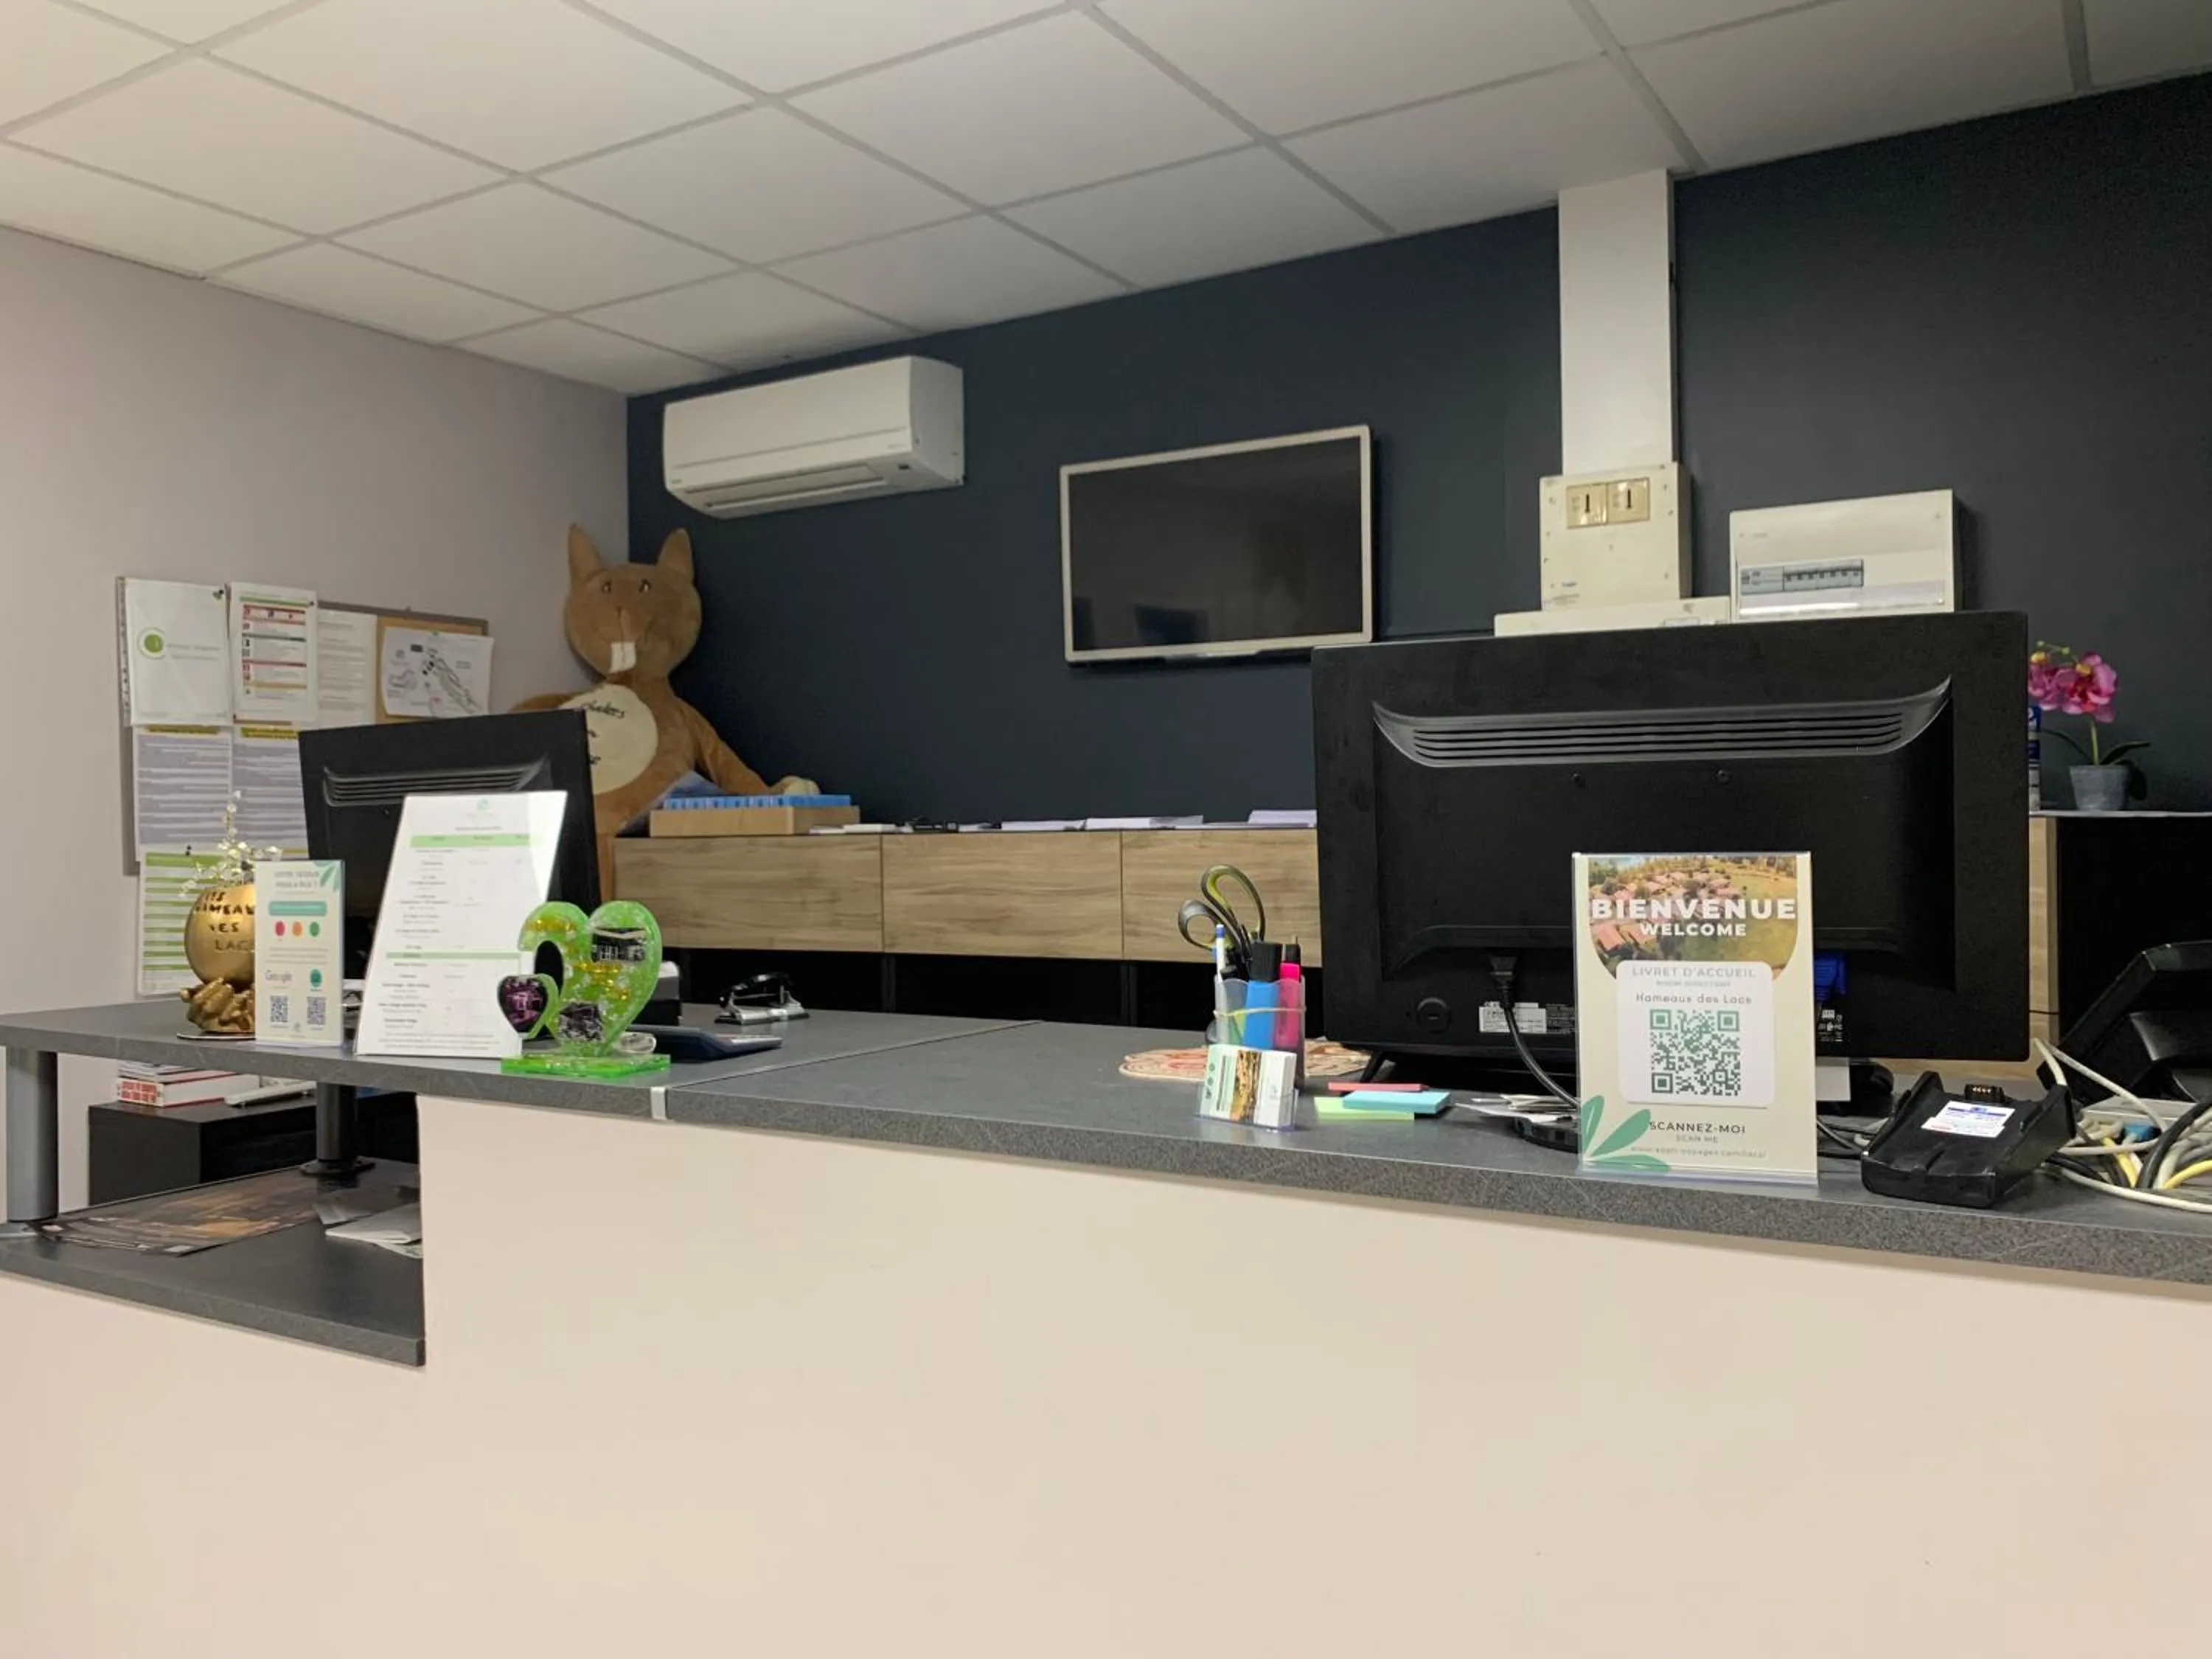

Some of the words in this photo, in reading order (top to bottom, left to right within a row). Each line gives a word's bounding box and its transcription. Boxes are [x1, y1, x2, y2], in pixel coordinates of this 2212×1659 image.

[1591, 898, 1796, 920] BIENVENUE
[1640, 923, 1747, 936] WELCOME
[1632, 967, 1677, 977] LIVRET
[1683, 967, 1756, 978] D'ACCUEIL
[1636, 993, 1692, 1004] Hameaux
[1697, 993, 1719, 1004] des
[1723, 995, 1752, 1004] Lacs
[1649, 1121, 1745, 1134] SCANNEZ-MOI
